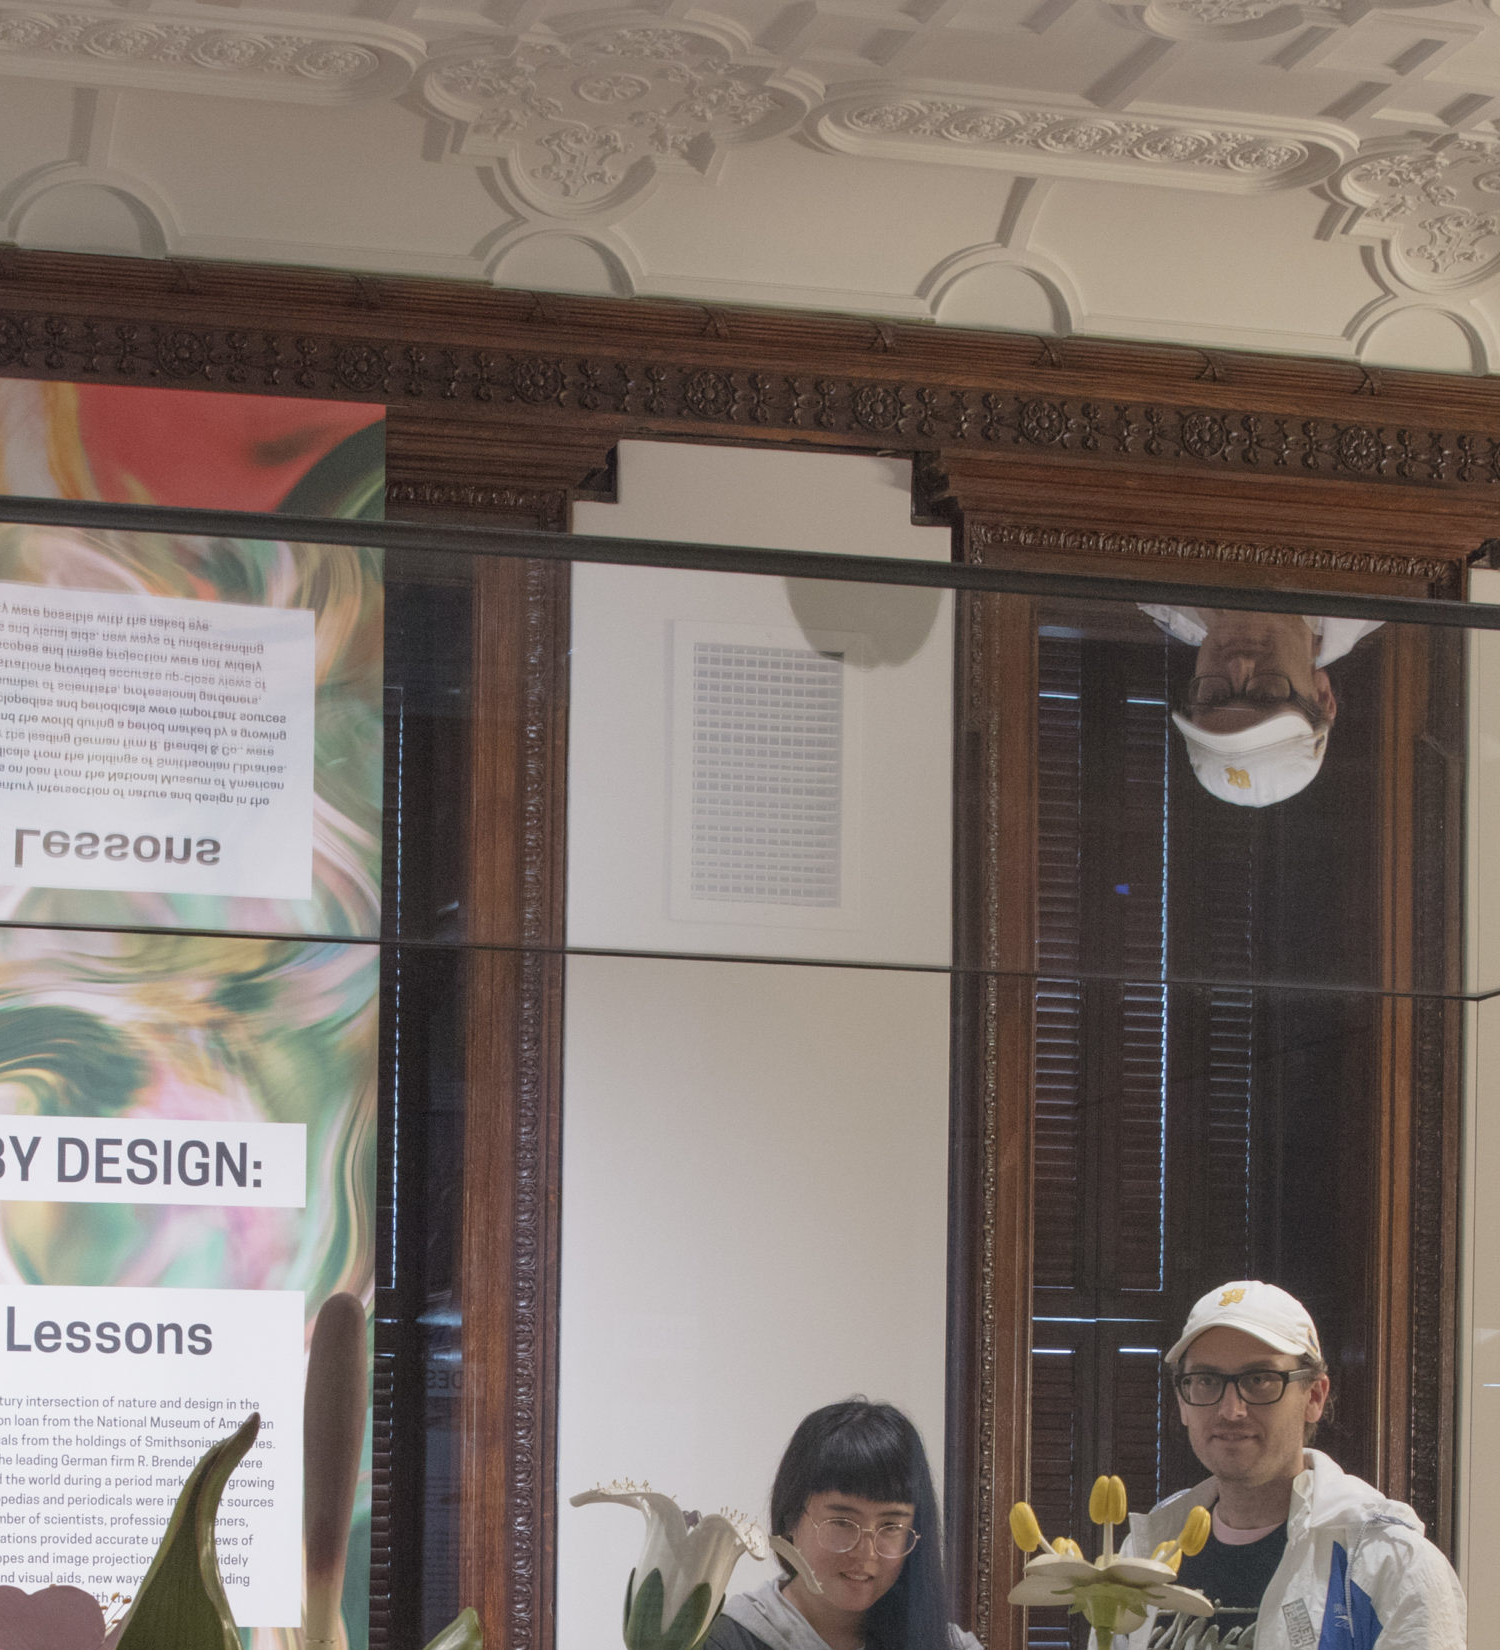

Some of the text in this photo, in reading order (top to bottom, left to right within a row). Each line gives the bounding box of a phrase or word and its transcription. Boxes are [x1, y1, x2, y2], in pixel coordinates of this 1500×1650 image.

[57, 1136, 262, 1188] DESIGN:
[6, 1305, 213, 1356] Lessons
[26, 1395, 99, 1408] intersection
[102, 1395, 115, 1408] of
[117, 1397, 157, 1409] nature
[159, 1396, 182, 1409] and
[184, 1396, 224, 1413] design
[226, 1398, 237, 1410] in
[238, 1397, 260, 1410] the
[14, 1414, 40, 1427] loan
[42, 1414, 71, 1427] from
[73, 1415, 94, 1428] the
[96, 1415, 147, 1429] National
[149, 1415, 201, 1429] Museum
[202, 1416, 216, 1429] of
[218, 1416, 274, 1430] Amean
[21, 1433, 50, 1446] from
[52, 1434, 73, 1447] the
[75, 1434, 127, 1450] holdings
[129, 1434, 142, 1448] of
[15, 1453, 59, 1469] leading
[60, 1454, 108, 1467] German
[110, 1454, 135, 1467] firm
[137, 1454, 149, 1467] R.
[151, 1455, 196, 1467] Brendel
[1283, 1605, 1303, 1648] COOPER
